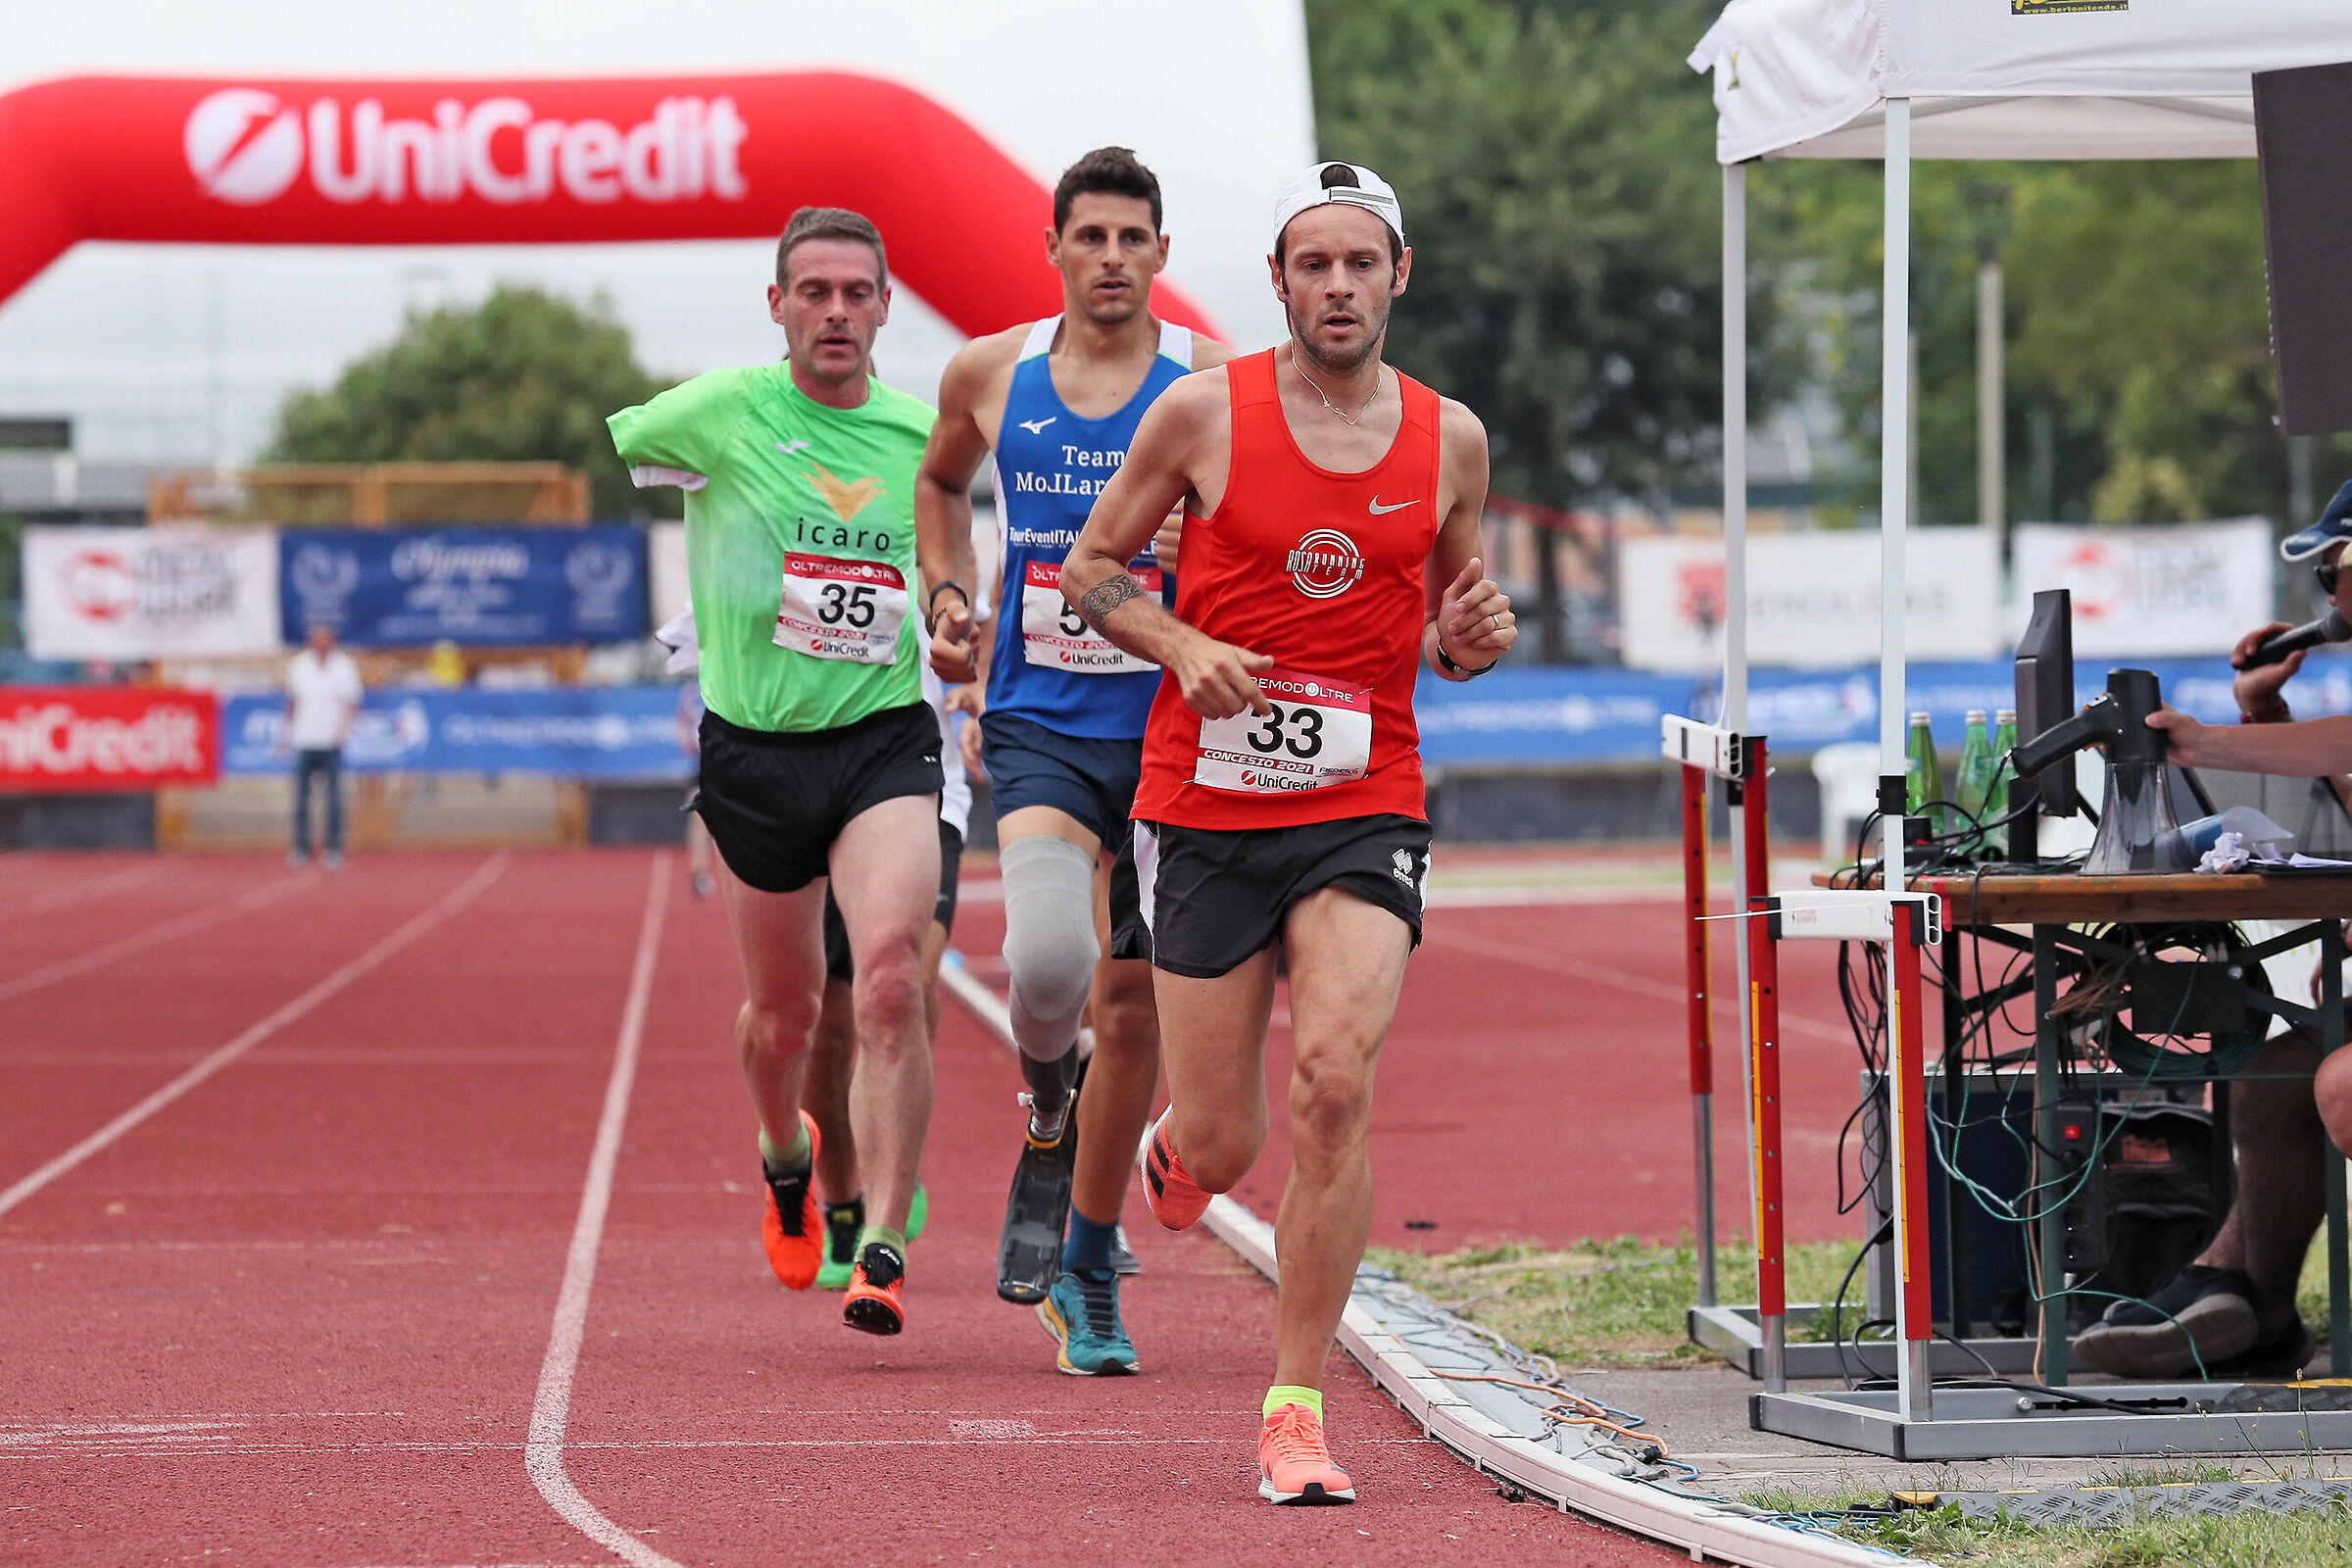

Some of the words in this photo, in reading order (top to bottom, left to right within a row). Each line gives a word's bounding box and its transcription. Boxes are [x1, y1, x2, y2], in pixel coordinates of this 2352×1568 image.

[308, 94, 749, 204] UniCredit
[1061, 445, 1126, 466] Team
[797, 517, 891, 551] icaro
[1286, 549, 1312, 573] ROSA
[1313, 552, 1365, 569] RUNNING
[1311, 564, 1363, 580] TEAM
[817, 583, 876, 628] 35
[1058, 601, 1088, 637] 5
[823, 641, 869, 658] UniCredit
[1072, 652, 1124, 665] UniCredit
[0, 704, 205, 773] niCredit
[1247, 702, 1325, 760] 33
[1203, 750, 1275, 769] CONCESIO
[1276, 760, 1312, 774] 2021
[1257, 772, 1319, 791] UniCredit
